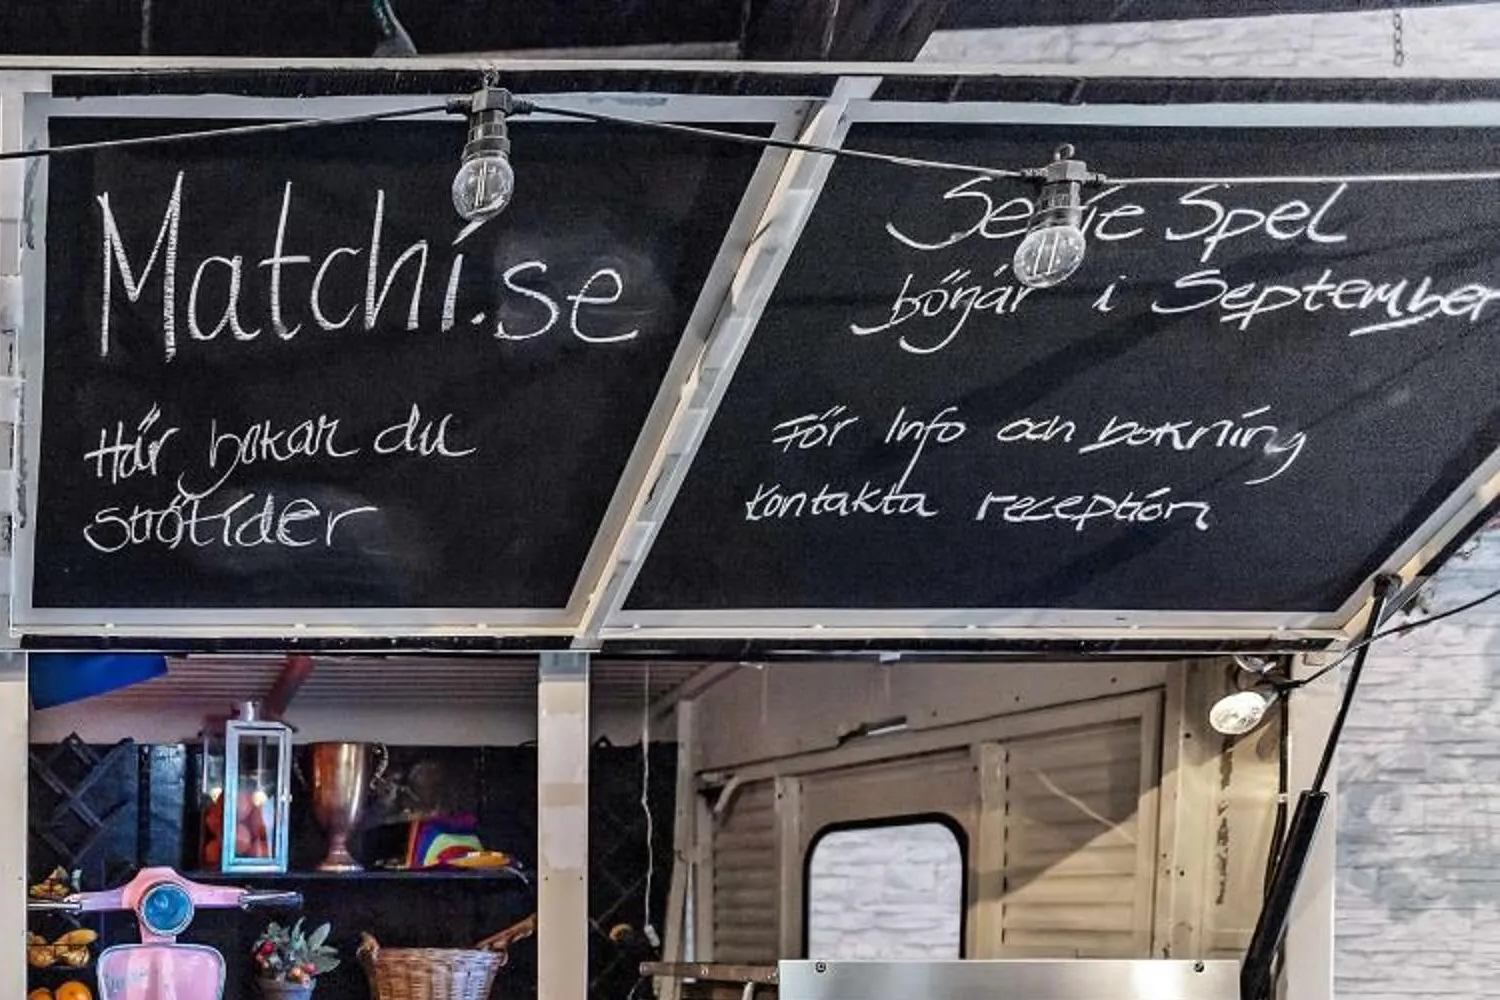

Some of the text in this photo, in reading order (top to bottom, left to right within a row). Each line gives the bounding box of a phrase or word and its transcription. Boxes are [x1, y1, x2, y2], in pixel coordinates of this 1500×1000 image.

[885, 175, 1349, 263] Seie Spel
[97, 170, 638, 363] Matchi.se
[850, 265, 1500, 354] börjar i September
[83, 401, 477, 500] Här bokar du
[771, 404, 858, 453] För
[997, 416, 1077, 443] och
[1078, 405, 1307, 486] bokning
